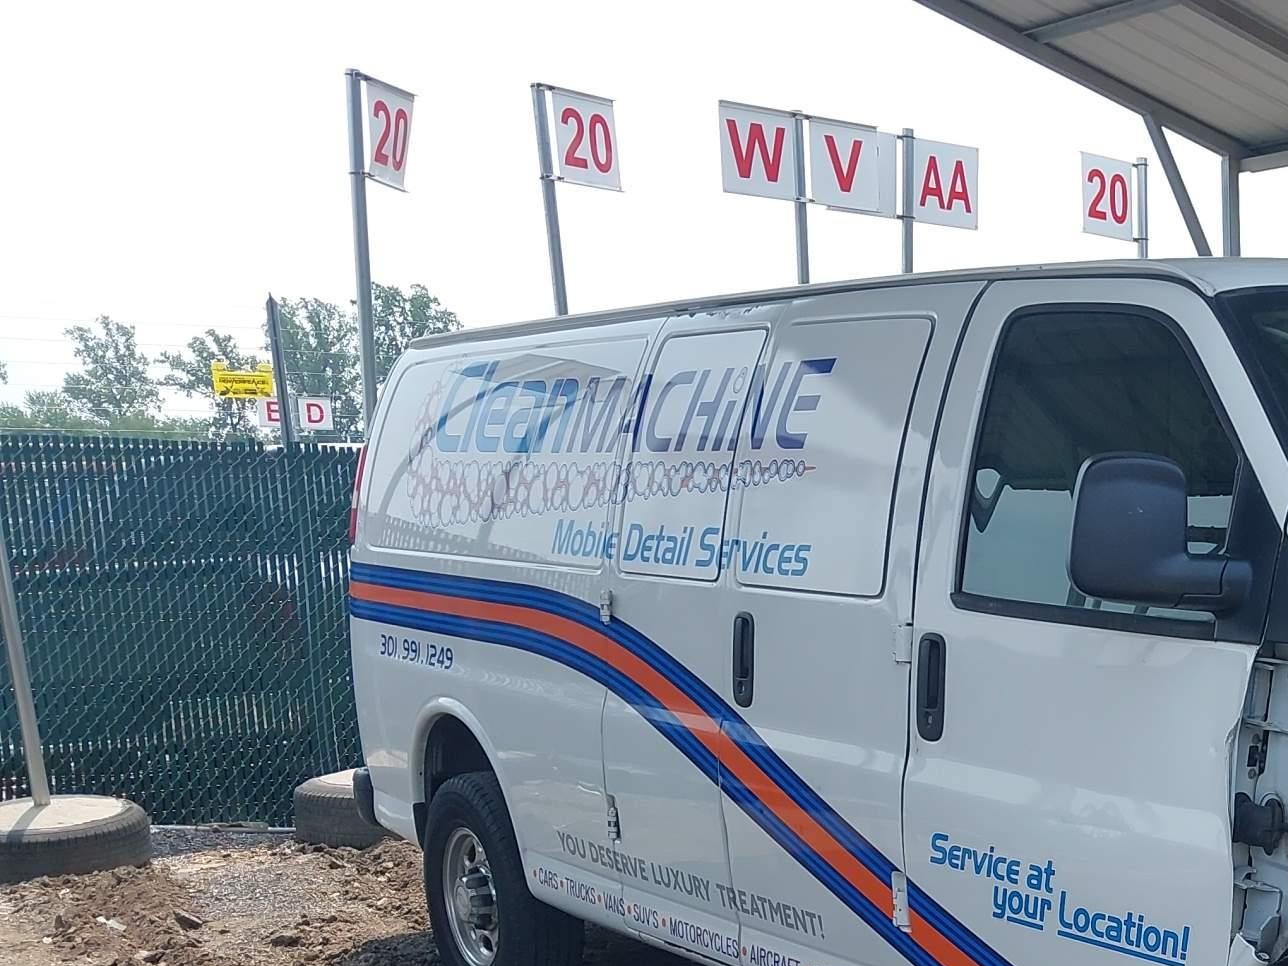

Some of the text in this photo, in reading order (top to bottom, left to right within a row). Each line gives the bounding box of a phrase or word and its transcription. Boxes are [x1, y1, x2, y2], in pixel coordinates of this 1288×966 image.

[373, 99, 409, 172] 20
[561, 107, 613, 174] 20
[725, 118, 785, 183] W
[824, 134, 862, 193] V
[919, 155, 971, 214] AA
[1087, 168, 1129, 225] 20
[305, 403, 324, 424] D
[552, 518, 812, 577] Mobile Detail Services
[556, 830, 825, 940] YOU DESERVE LUXURY TREATMENT!
[929, 832, 1056, 893] Service at
[538, 867, 559, 890] CARS
[565, 877, 597, 905] TRUCKS
[602, 891, 626, 917] VANS
[633, 903, 659, 929] SUV'S
[669, 917, 740, 960] MOTORCYCLES
[992, 885, 1191, 961] your Location!
